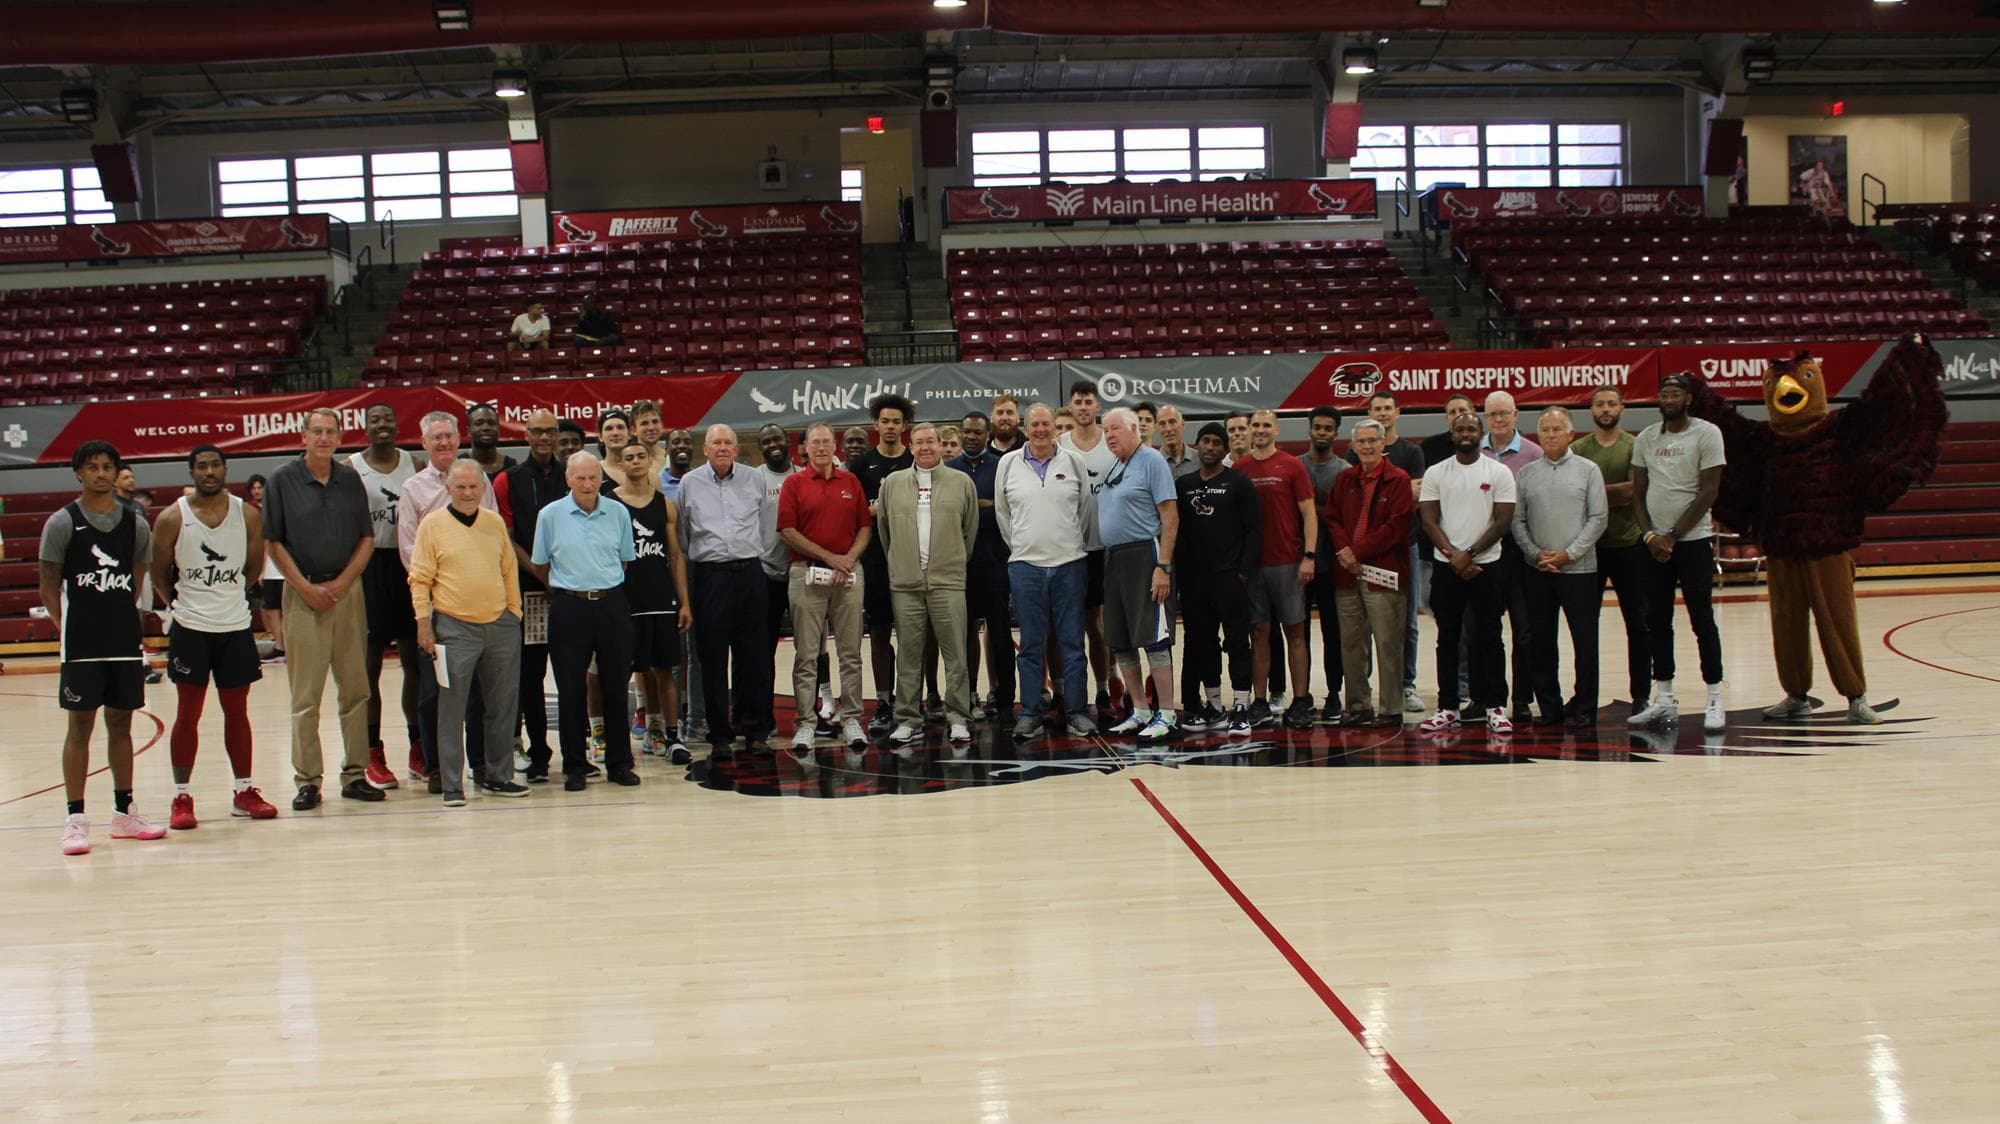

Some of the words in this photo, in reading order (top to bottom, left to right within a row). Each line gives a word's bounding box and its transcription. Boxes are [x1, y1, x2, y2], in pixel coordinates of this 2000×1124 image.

[1092, 194, 1146, 216] Main
[1150, 193, 1197, 213] Line
[608, 216, 678, 237] RAFFERTY
[743, 214, 806, 226] LANDMARK
[0, 234, 59, 244] MERALD
[1131, 376, 1262, 396] ROTHMAN
[1388, 369, 1440, 391] SAINT
[1443, 367, 1525, 390] JOSEPH'S
[1529, 364, 1630, 388] UNIVERSITY
[792, 380, 861, 416] HAWK
[925, 388, 1040, 399] PHILADELPHIA
[1337, 383, 1373, 396] SJU
[553, 403, 594, 420] Line
[134, 424, 209, 437] WELCOME
[216, 423, 235, 433] TO
[635, 537, 666, 559] JACK
